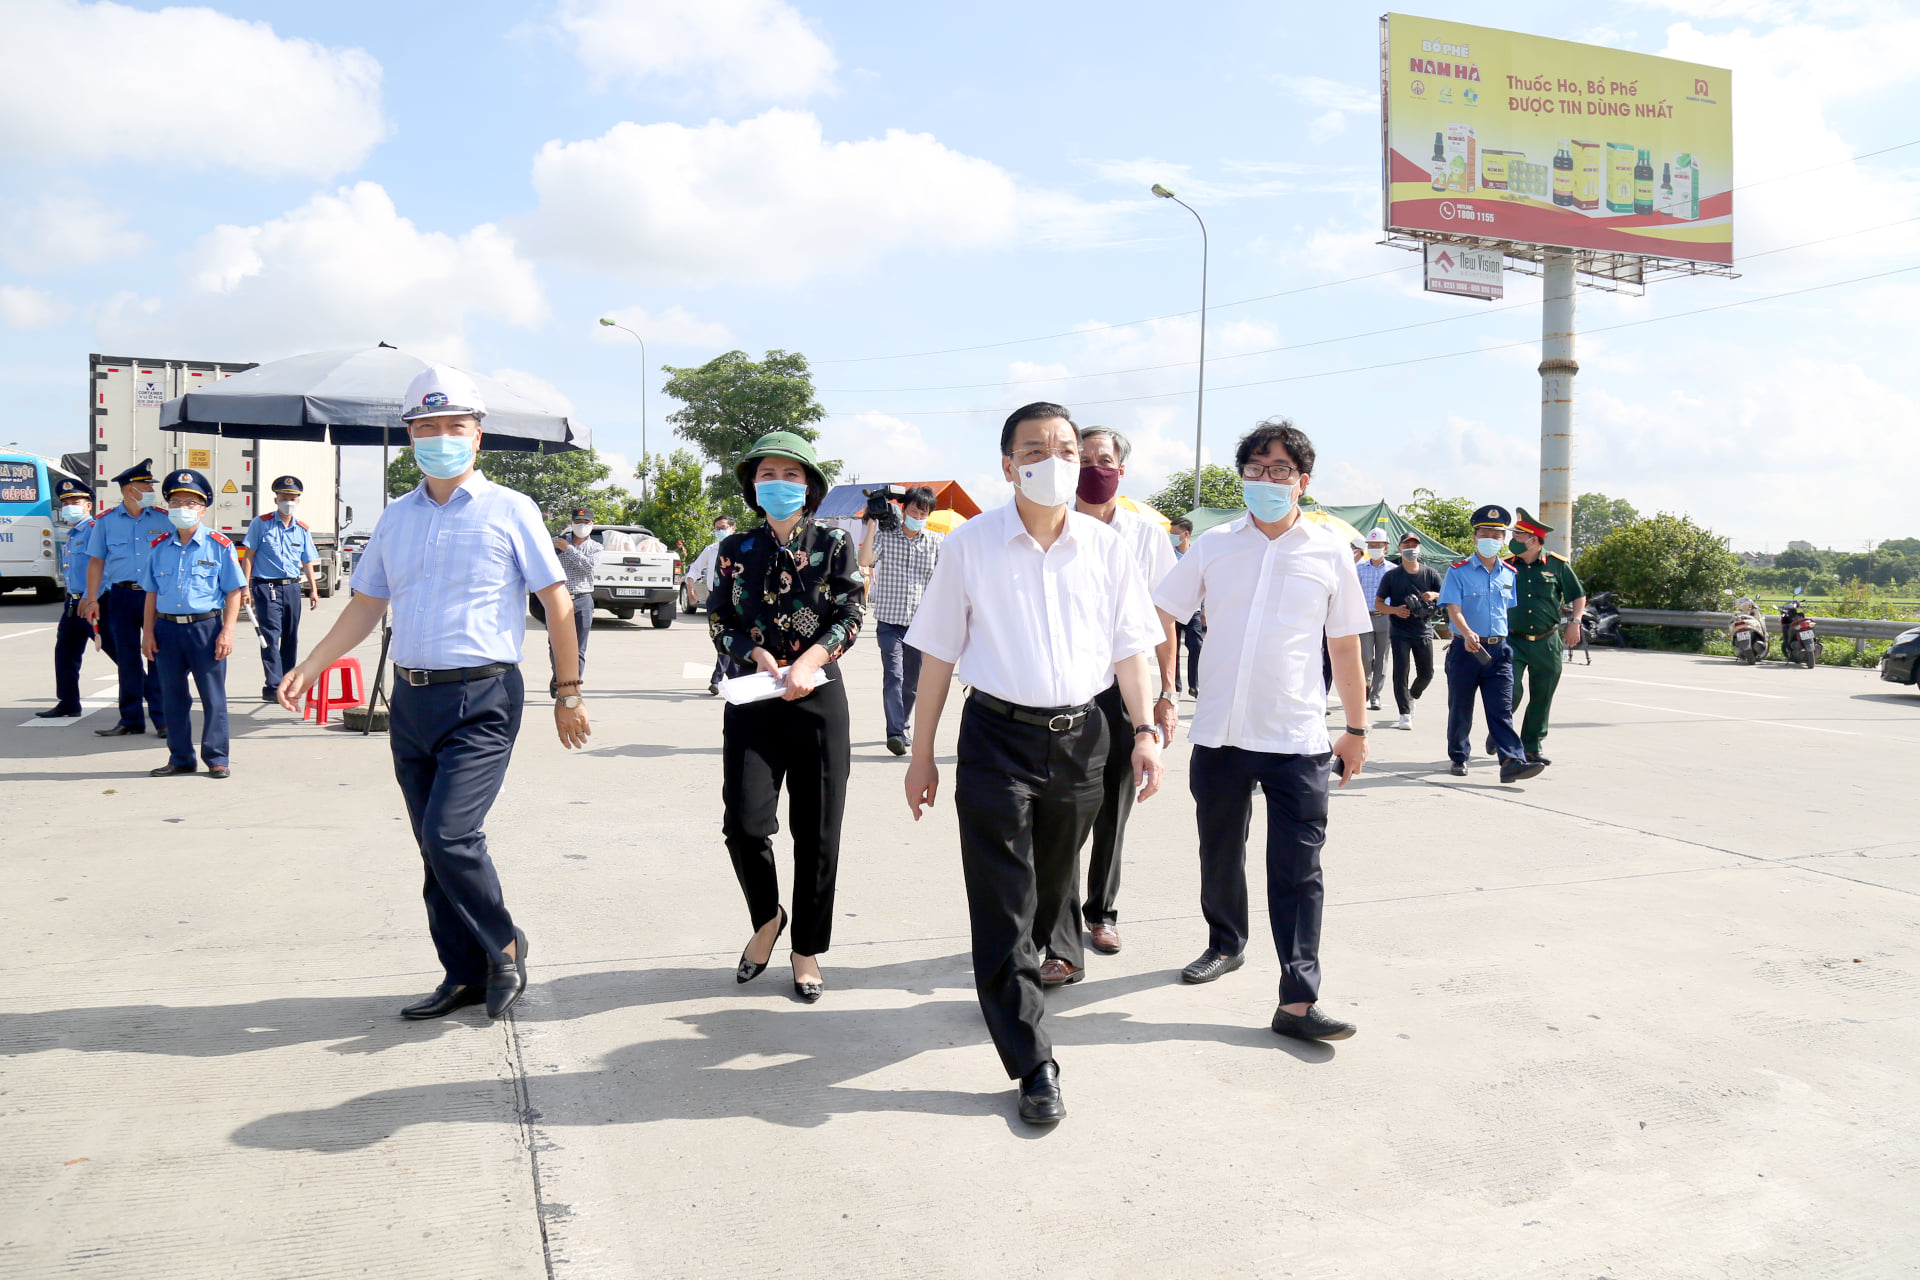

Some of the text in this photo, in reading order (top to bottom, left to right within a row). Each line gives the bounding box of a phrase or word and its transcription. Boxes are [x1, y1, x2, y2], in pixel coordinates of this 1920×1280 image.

[1410, 58, 1481, 81] NAM HÀ
[1506, 74, 1638, 96] Thuốc Ho, Bổ Phế
[1508, 96, 1555, 117] ĐƯỢC
[1559, 100, 1582, 114] TIN
[1587, 99, 1630, 116] DÙNG
[1635, 98, 1673, 119] NHẤT
[1457, 210, 1495, 223] 1800 1155
[1460, 251, 1500, 273] New Vision
[12, 465, 33, 479] NỘI
